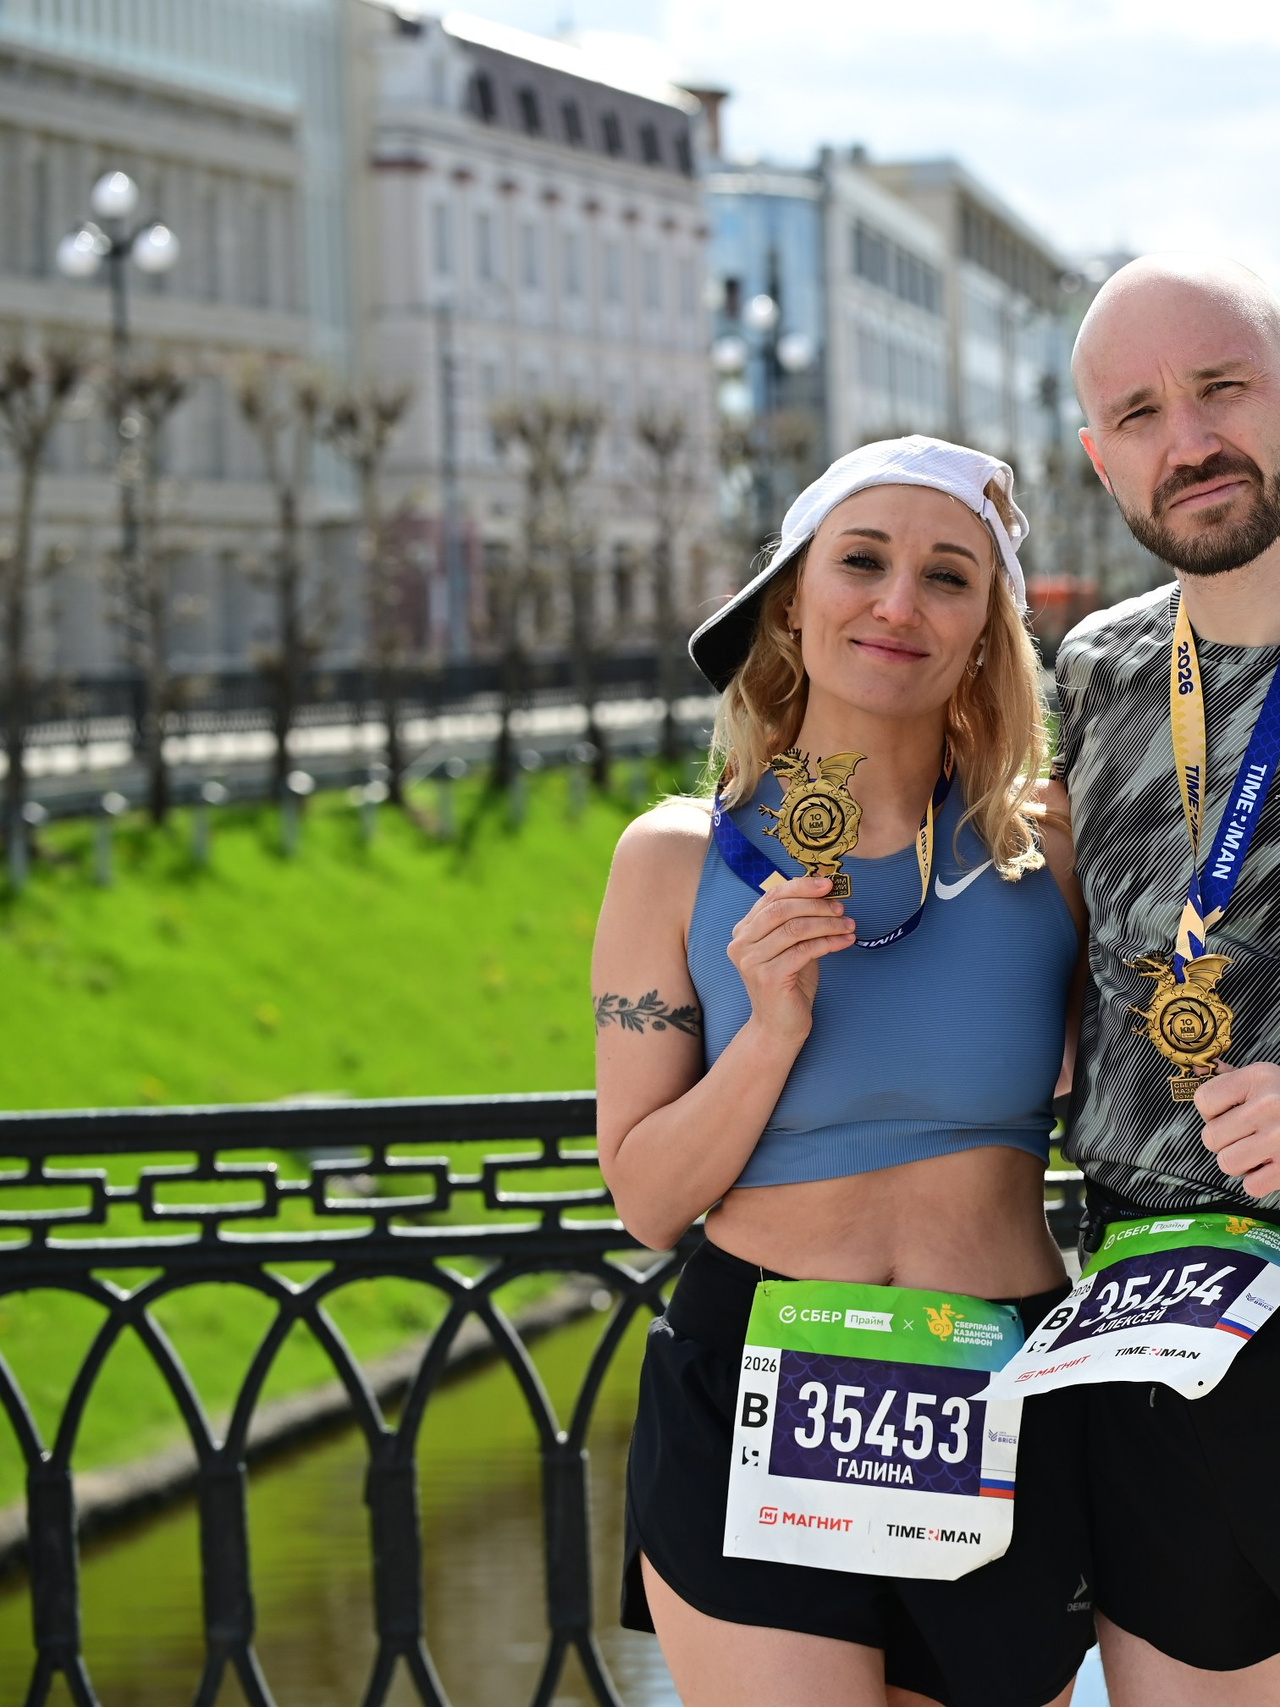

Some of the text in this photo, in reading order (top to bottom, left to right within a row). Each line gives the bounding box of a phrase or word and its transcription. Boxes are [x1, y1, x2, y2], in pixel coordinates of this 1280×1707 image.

[1177, 641, 1194, 695] 2026
[810, 813, 822, 821] 10
[1180, 1018, 1193, 1026] 10
[1116, 1221, 1185, 1241] СБЕР Прайм
[1068, 1281, 1093, 1299] 2026
[1079, 1262, 1238, 1328] 35454
[800, 1309, 884, 1327] СБЕР Прайм
[954, 1320, 999, 1333] СБЕРПРАЙМ
[1092, 1305, 1169, 1335] АЛЕКСЕЙ
[953, 1328, 1003, 1341] КАЗАНСКИЙ
[953, 1336, 993, 1347] МАРАФОН
[744, 1356, 777, 1373] 2026
[1034, 1354, 1091, 1378] МАГНИТ
[794, 1381, 970, 1463] 35453
[998, 1437, 1017, 1445] BRICS
[837, 1458, 914, 1485] ГАЛИНА
[782, 1511, 853, 1532] МАГНИТ
[1066, 1602, 1092, 1612] DEMIX
